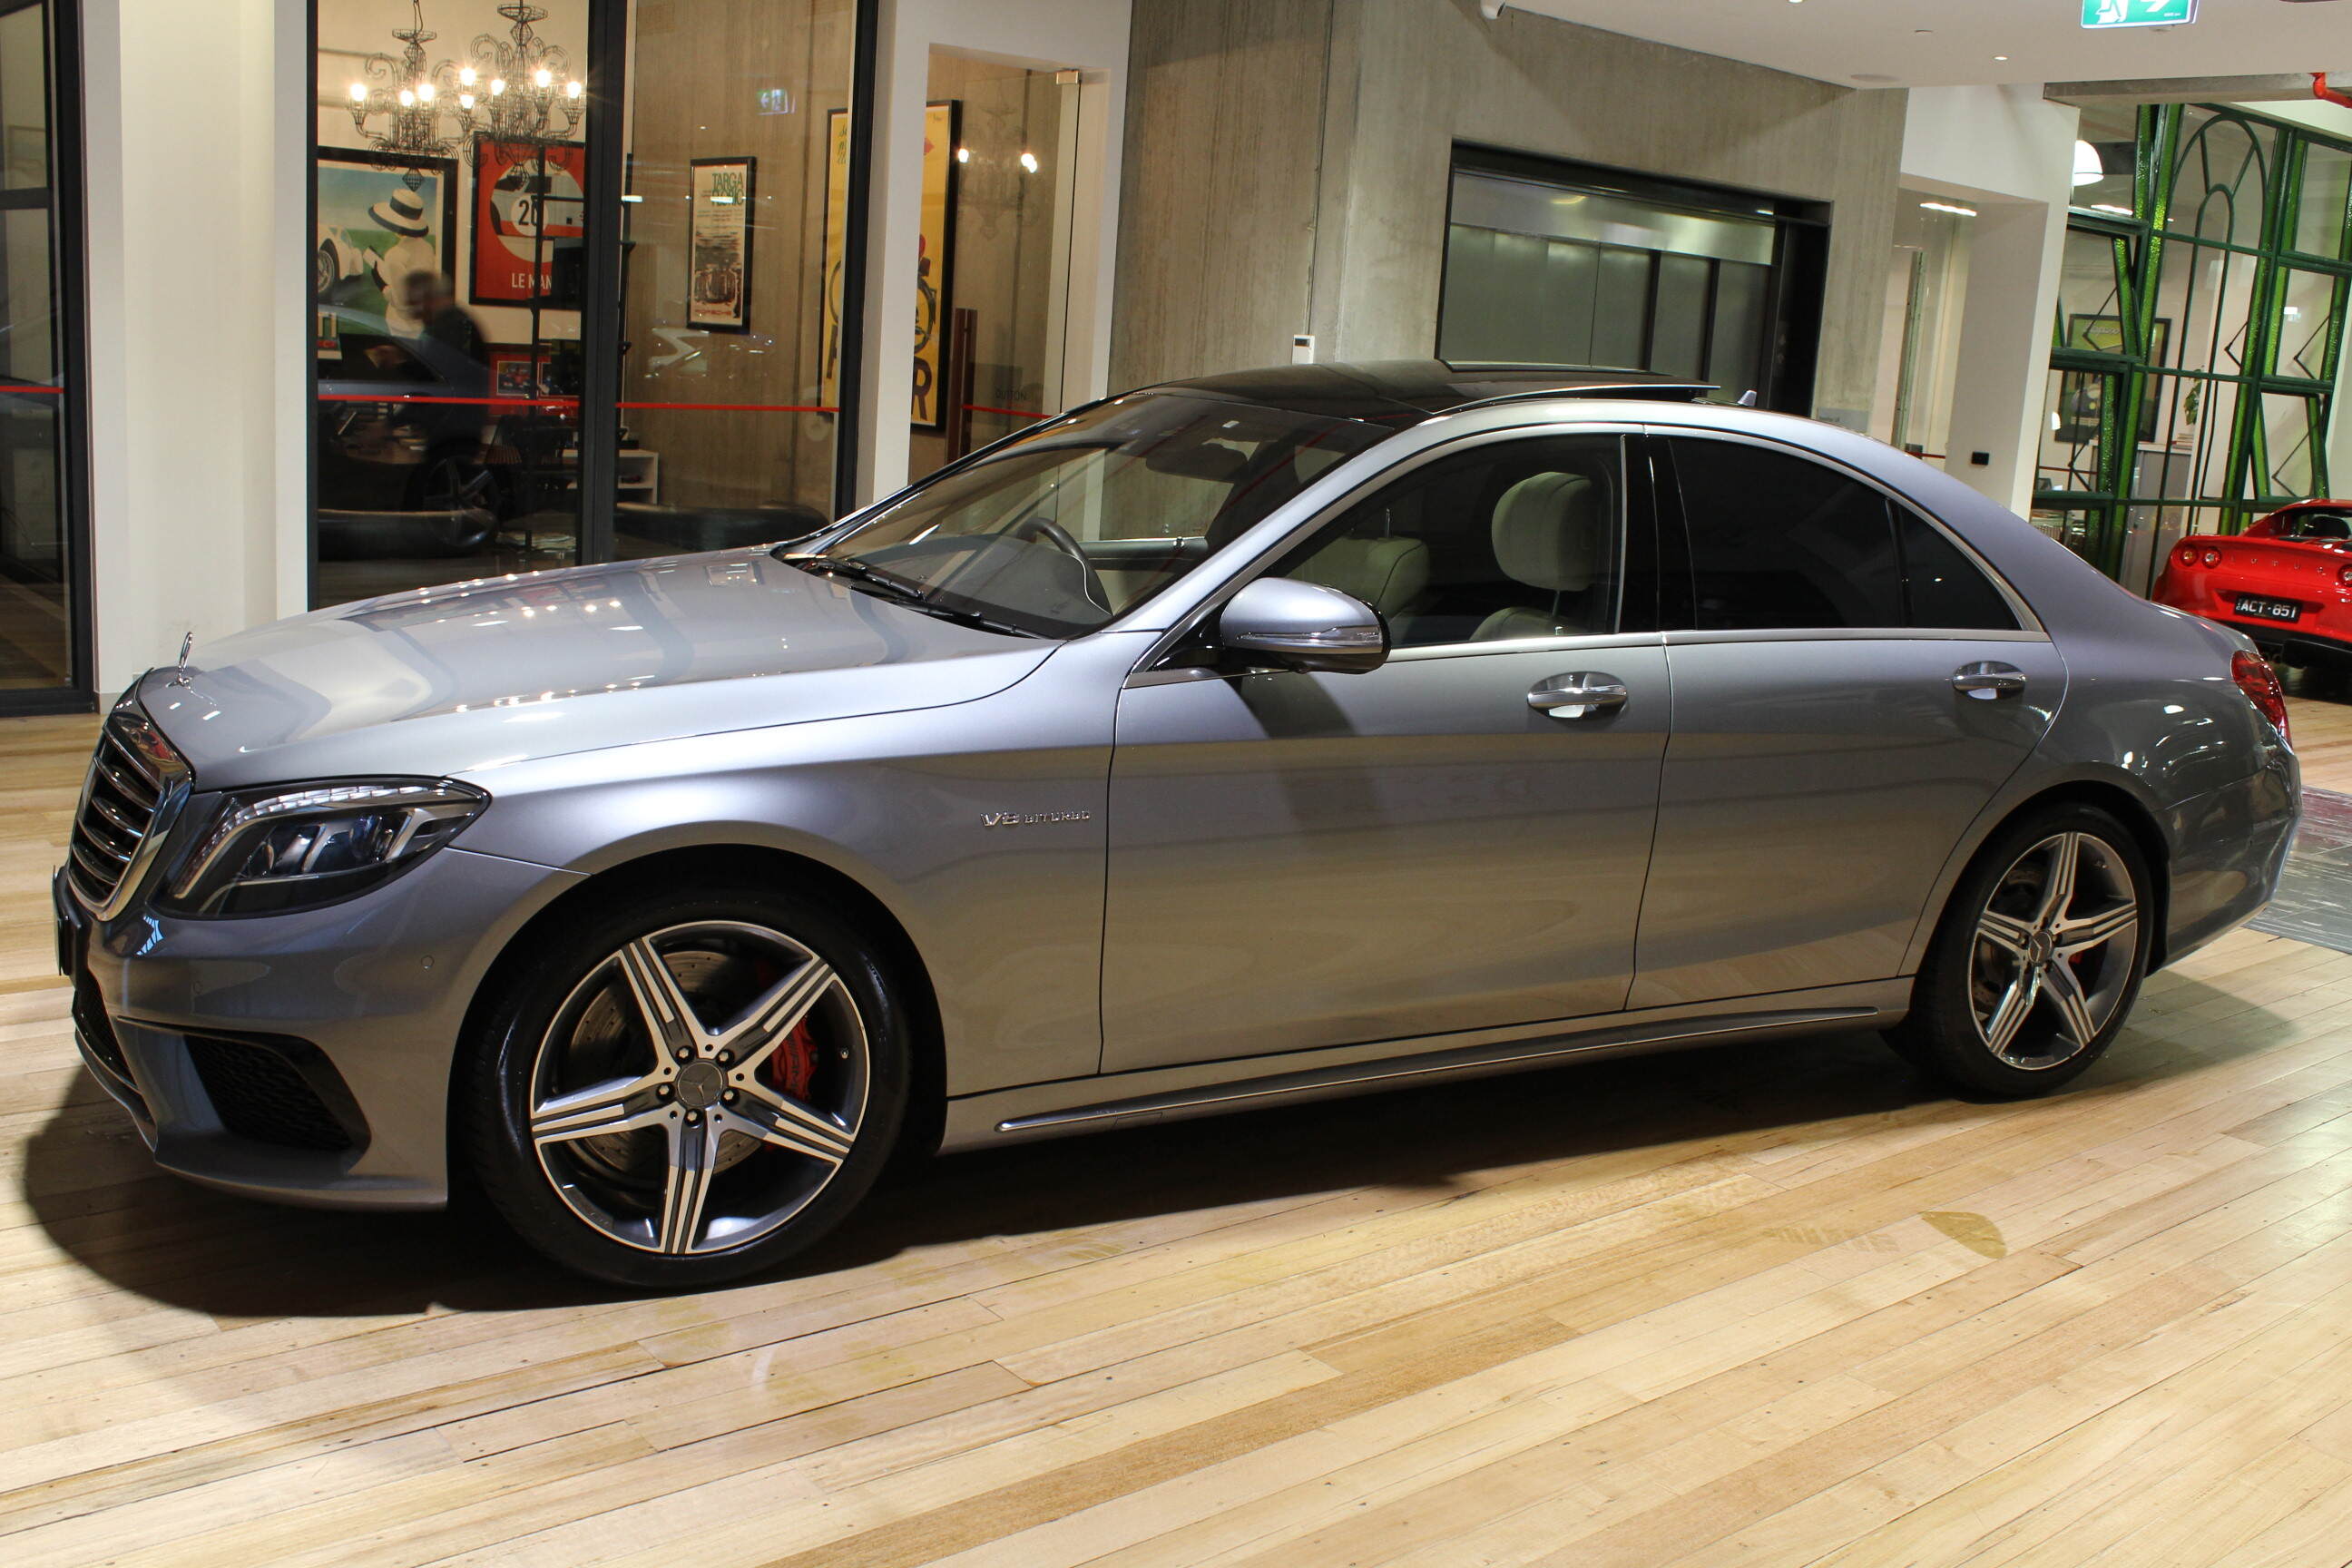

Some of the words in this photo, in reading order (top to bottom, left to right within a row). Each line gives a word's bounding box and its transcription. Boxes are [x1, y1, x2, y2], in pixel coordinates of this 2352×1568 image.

[712, 172, 743, 189] TARGA
[512, 272, 525, 289] LE
[1024, 810, 1091, 824] BITURBO
